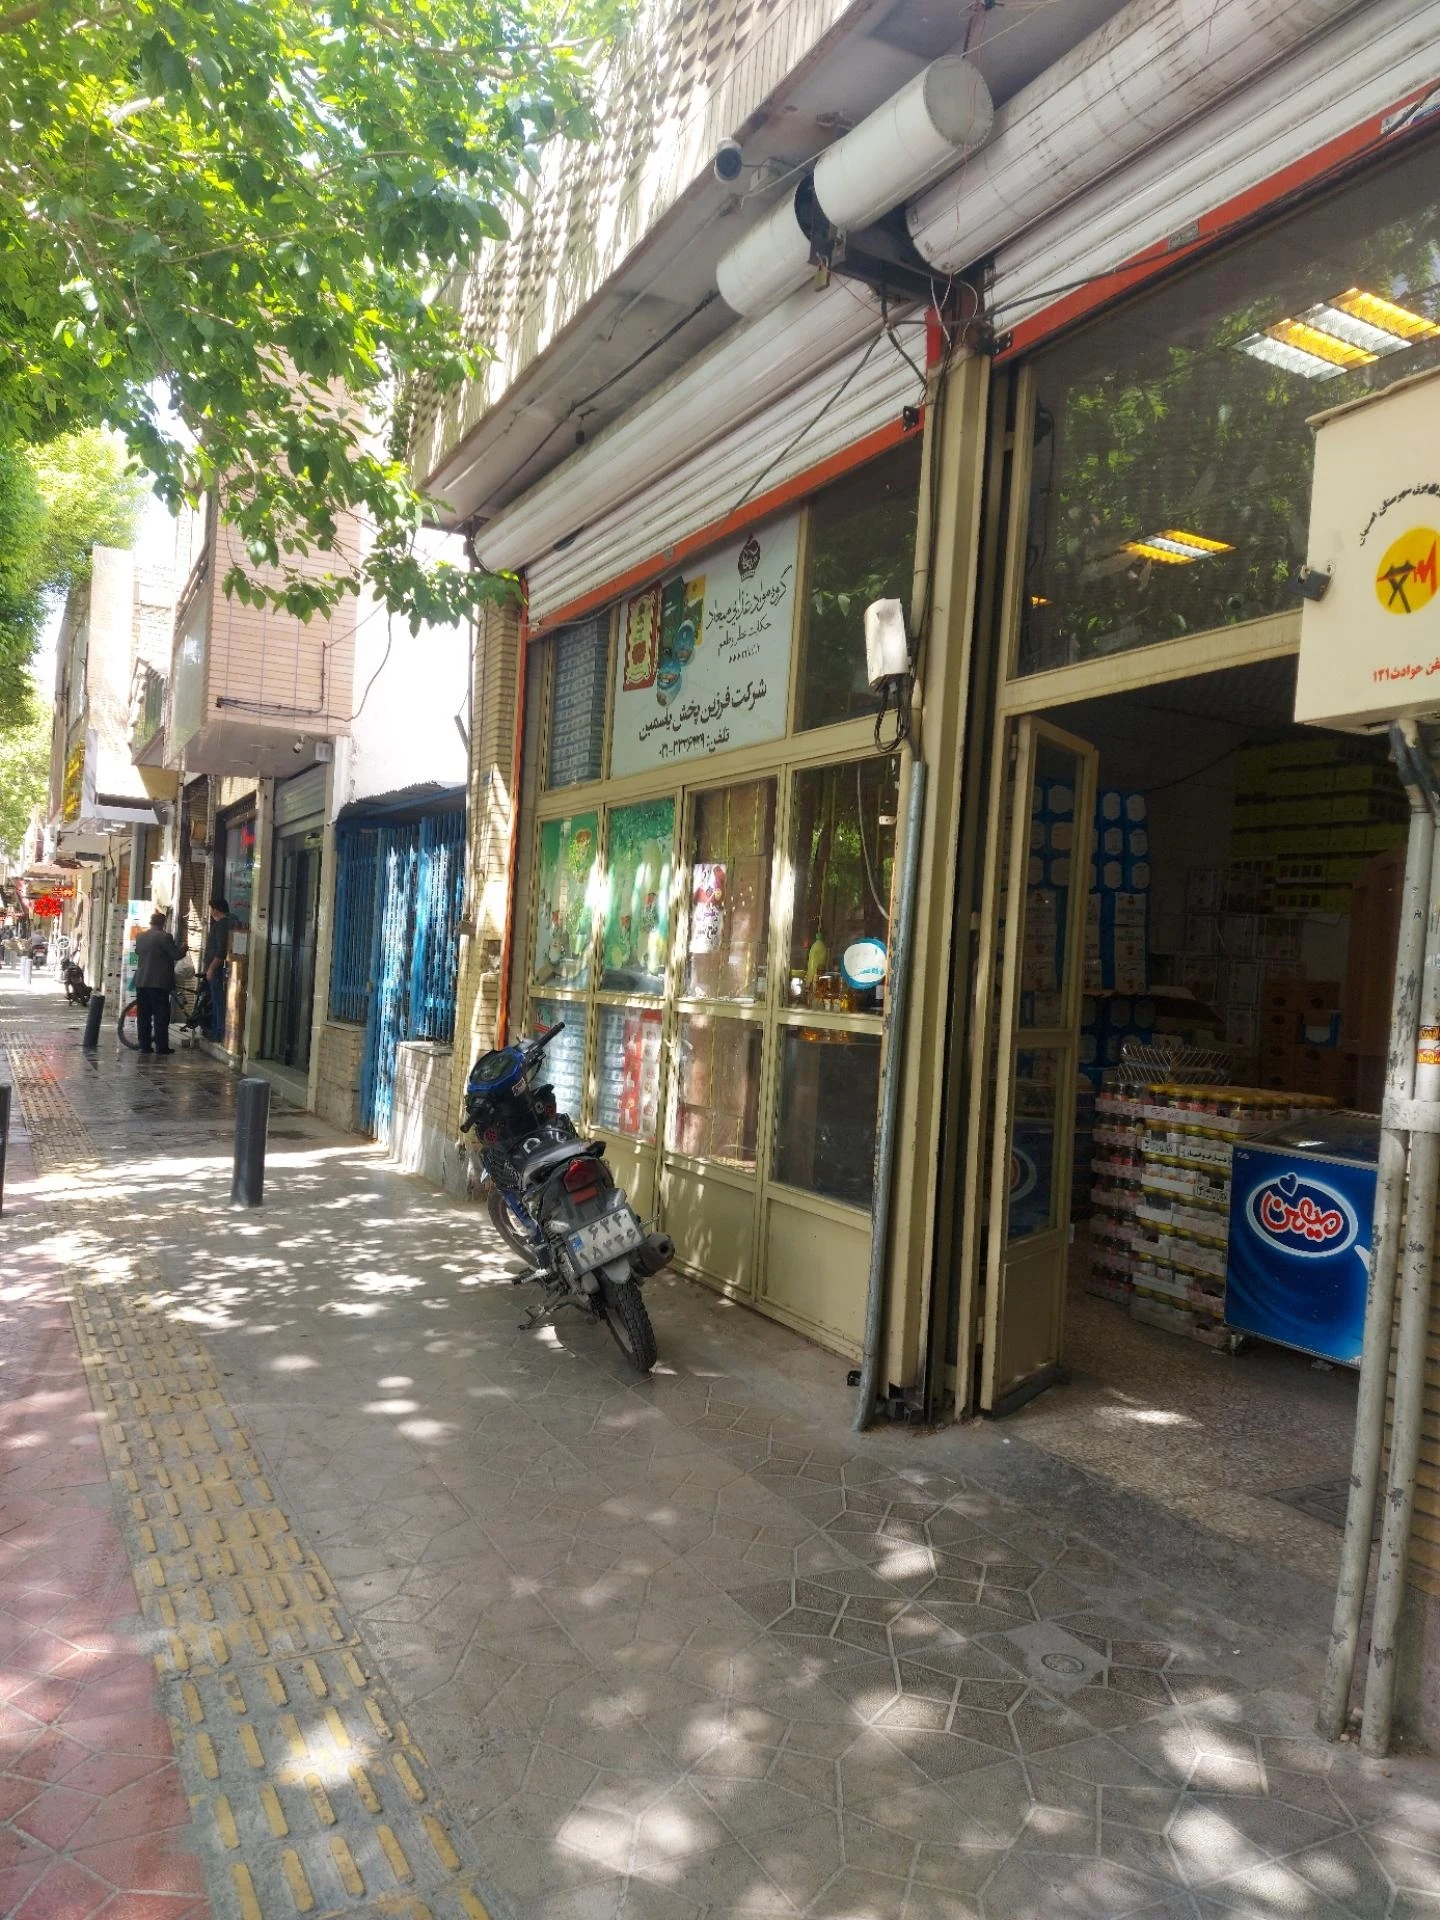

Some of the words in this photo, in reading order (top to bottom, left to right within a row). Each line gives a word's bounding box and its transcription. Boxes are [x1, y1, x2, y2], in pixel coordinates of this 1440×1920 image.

[731, 678, 767, 711] شرکت
[672, 699, 701, 732] پخش
[1260, 1190, 1344, 1242] میهن
